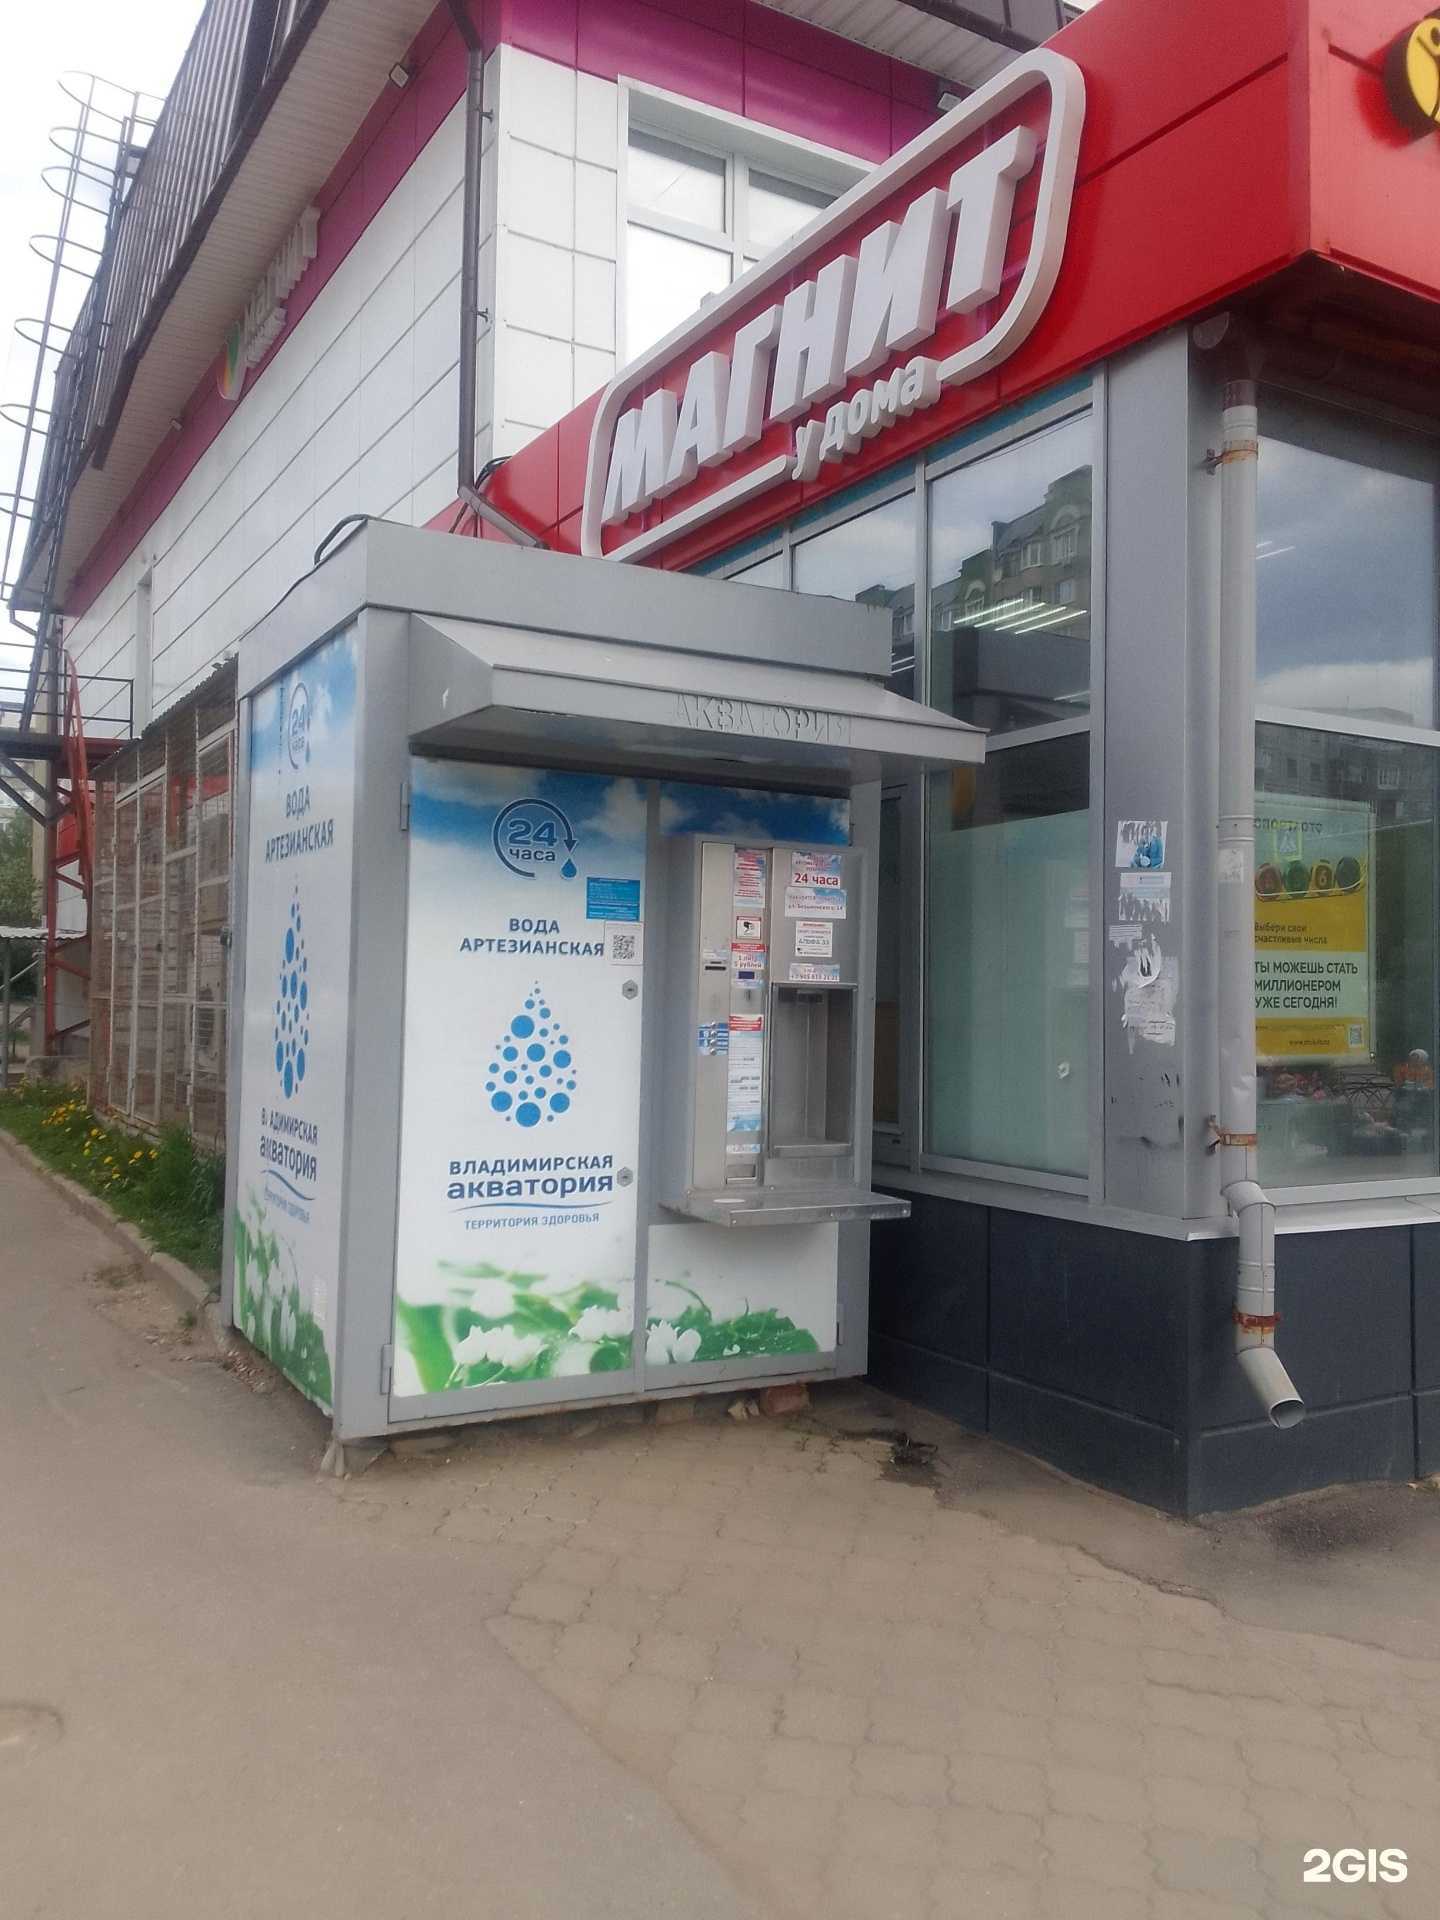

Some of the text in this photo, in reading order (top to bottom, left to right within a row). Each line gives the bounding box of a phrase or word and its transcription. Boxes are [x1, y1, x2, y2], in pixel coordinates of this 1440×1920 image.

[602, 126, 1043, 526] МАГНИТ
[792, 356, 943, 481] у дома
[286, 785, 310, 819] ВОДА
[265, 819, 334, 863] АРТЕЗИАНСКАЯ
[508, 820, 557, 847] 24
[508, 848, 556, 862] часа
[794, 872, 839, 886] 24 часа
[509, 918, 560, 934] ВОДА
[460, 938, 604, 956] АРТЕЗИАНСКАЯ
[1255, 961, 1358, 974] ТЫ МОЖЕШЬ СТАТЬ
[1255, 980, 1341, 992] МИЛЛИОНЕРОМ
[1255, 997, 1338, 1010] УЖЕ СЕГОДНЯ!
[260, 1135, 317, 1181] акватория
[450, 1155, 613, 1176] ВЛАДИМИРСКАЯ
[447, 1176, 613, 1199] акватория
[464, 1213, 600, 1230] ТЕРРИТОРИЯ ЗДОРОВЬЯ
